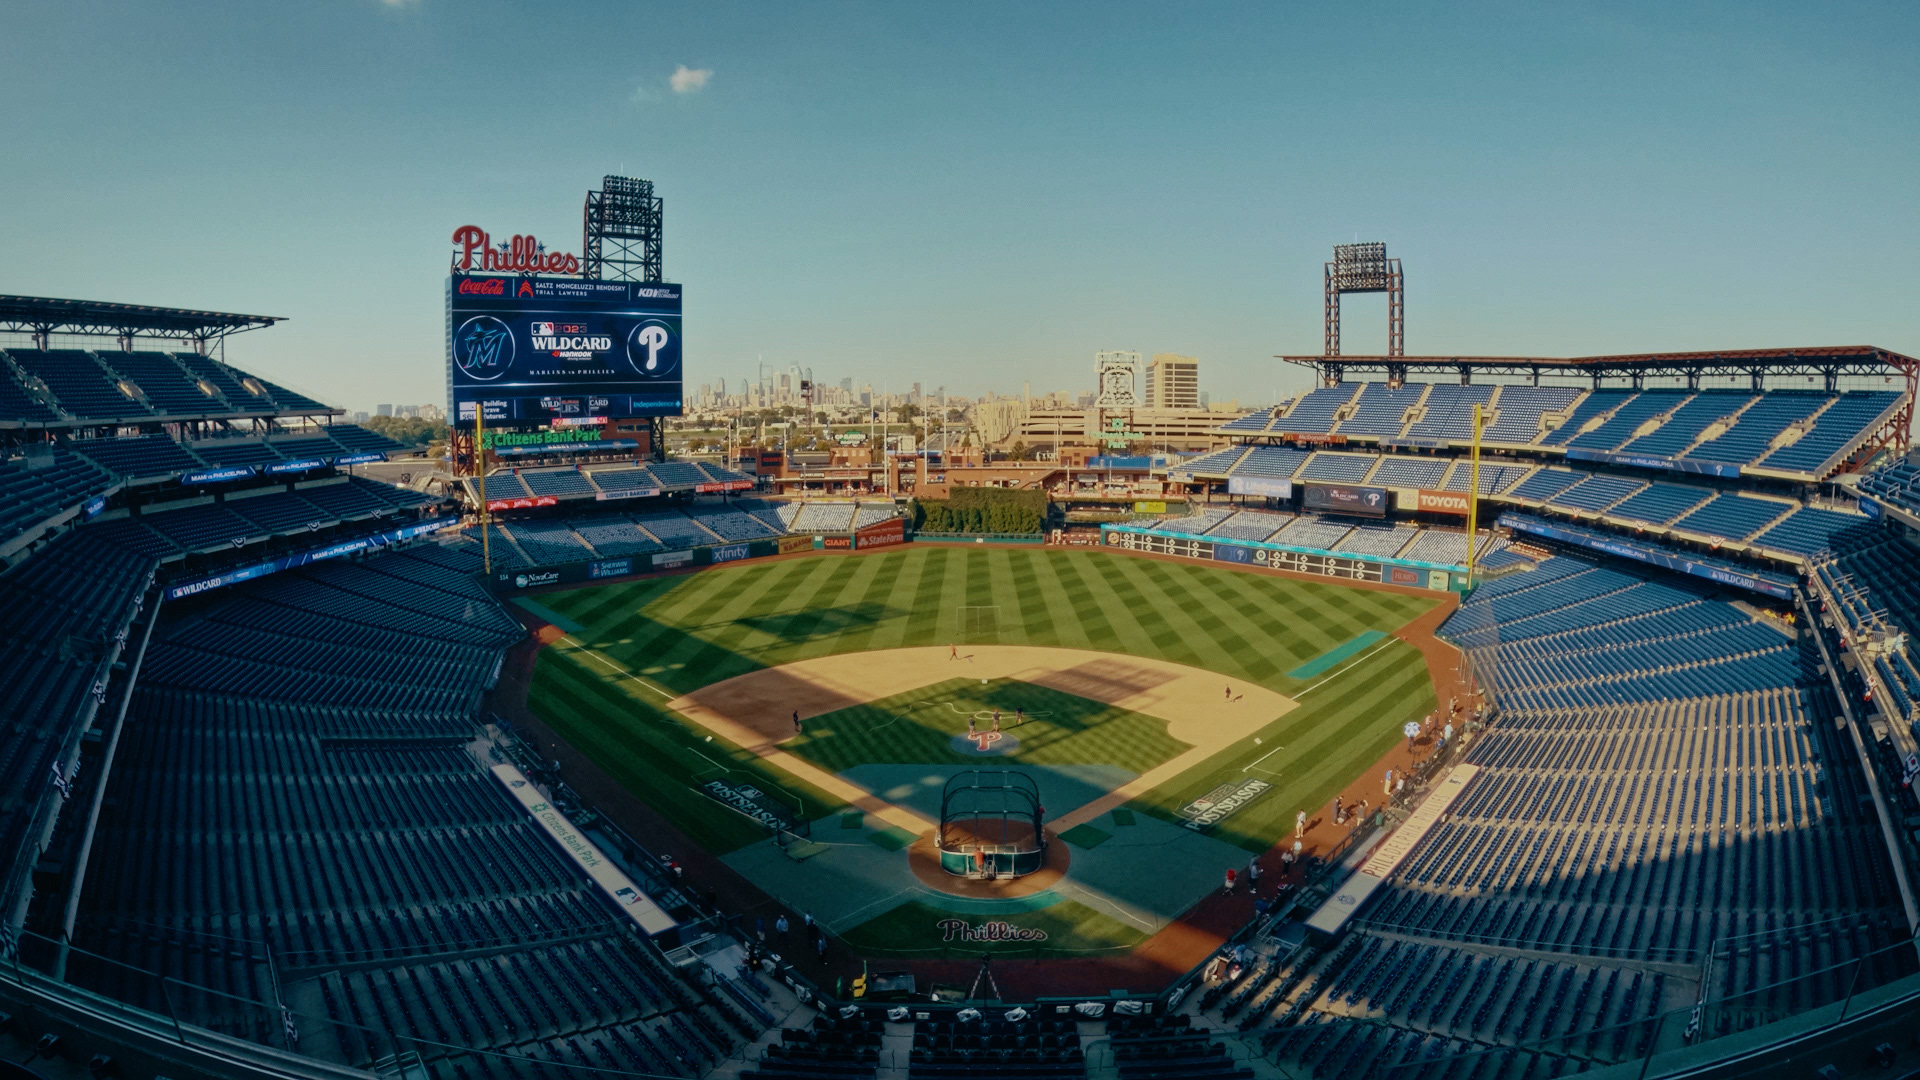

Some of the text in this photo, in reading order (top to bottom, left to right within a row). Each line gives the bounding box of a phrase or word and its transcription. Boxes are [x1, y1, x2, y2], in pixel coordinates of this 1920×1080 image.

[452, 225, 579, 274] Phillies
[459, 278, 505, 295] Coca-Cola
[555, 325, 588, 333] 2023
[638, 326, 668, 370] P
[483, 400, 507, 408] Building
[494, 428, 600, 446] Citizens Bank Park
[291, 461, 320, 470] PHILADELPHIA
[1637, 458, 1674, 468] PHILADELPHIA
[213, 469, 248, 480] PHILADELPHIA
[1420, 495, 1468, 509] TOYOTA
[312, 551, 329, 560] MIAMI
[334, 541, 367, 554] PHILADELPHIA
[714, 547, 748, 561] xfinity
[1611, 545, 1646, 559] PHILADELPHIA
[528, 572, 559, 581] NovaCare
[968, 732, 1002, 751] P
[705, 781, 792, 832] POSTSEASON
[1185, 780, 1269, 831] POSTSEASON
[542, 813, 569, 836] Citizens
[563, 835, 586, 853] Bank
[1362, 824, 1421, 878] PHILADELPHIA
[578, 850, 600, 867] Park
[937, 919, 1048, 942] Phillies
